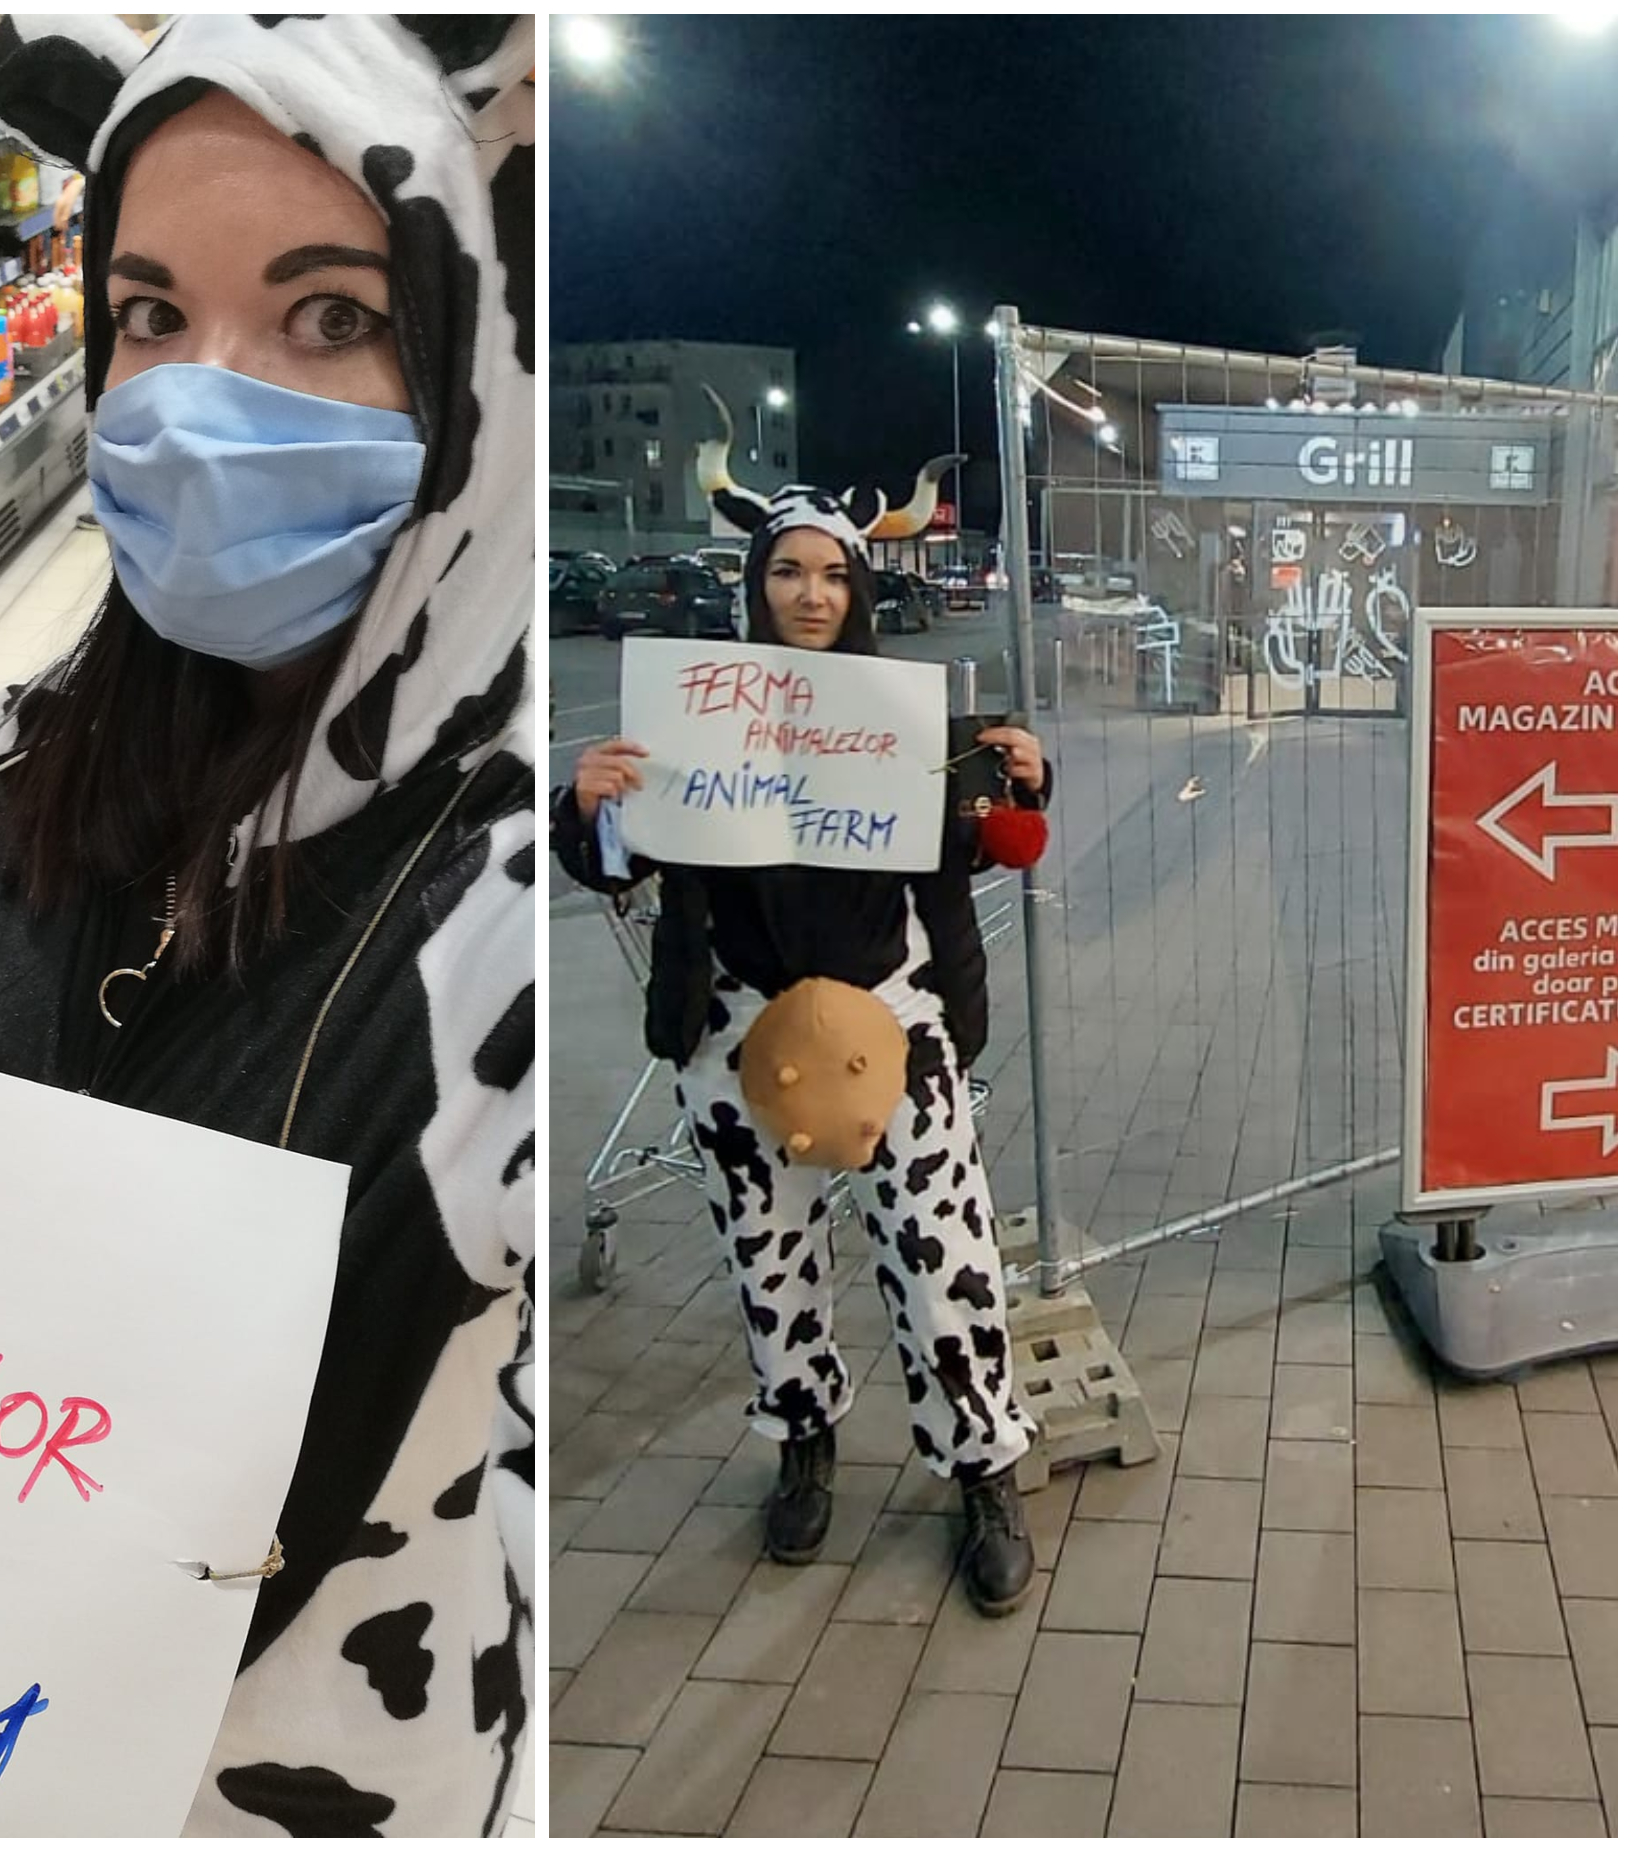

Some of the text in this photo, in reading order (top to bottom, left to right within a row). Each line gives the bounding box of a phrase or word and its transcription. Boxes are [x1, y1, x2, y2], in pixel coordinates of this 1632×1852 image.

[1298, 436, 1414, 486] Grill
[679, 660, 814, 717] FERMA
[744, 718, 897, 762] ANIMALELOR
[1458, 704, 1615, 732] MAGAZIN
[682, 760, 816, 812] ANIMAL
[788, 806, 898, 852] FARM
[1500, 917, 1588, 943] ACCES
[1473, 944, 1615, 976] din galeria
[1532, 972, 1595, 996] doar
